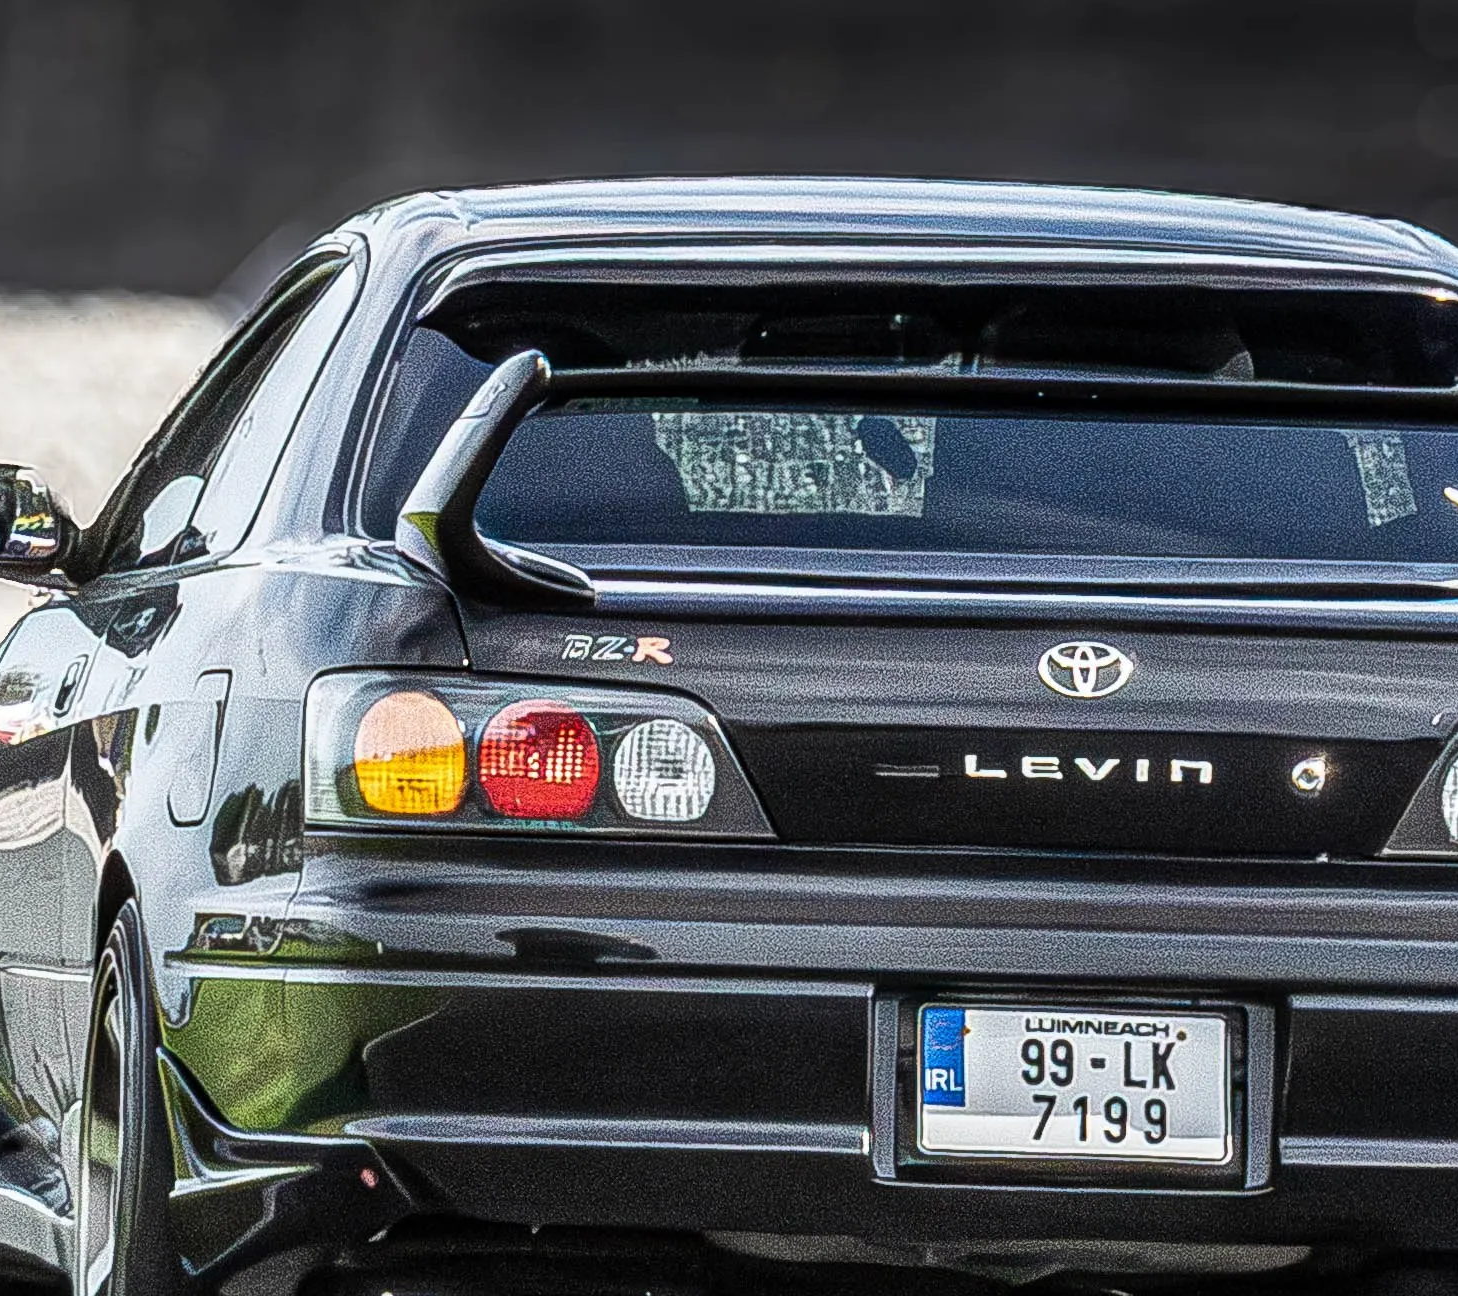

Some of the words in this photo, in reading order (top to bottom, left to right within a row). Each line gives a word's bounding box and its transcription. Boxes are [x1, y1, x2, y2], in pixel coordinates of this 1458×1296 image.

[964, 754, 1214, 785] LEVIN
[1024, 1017, 1170, 1038] LUIMNEACH
[925, 1068, 963, 1092] IRL
[1032, 1094, 1168, 1144] 7199
